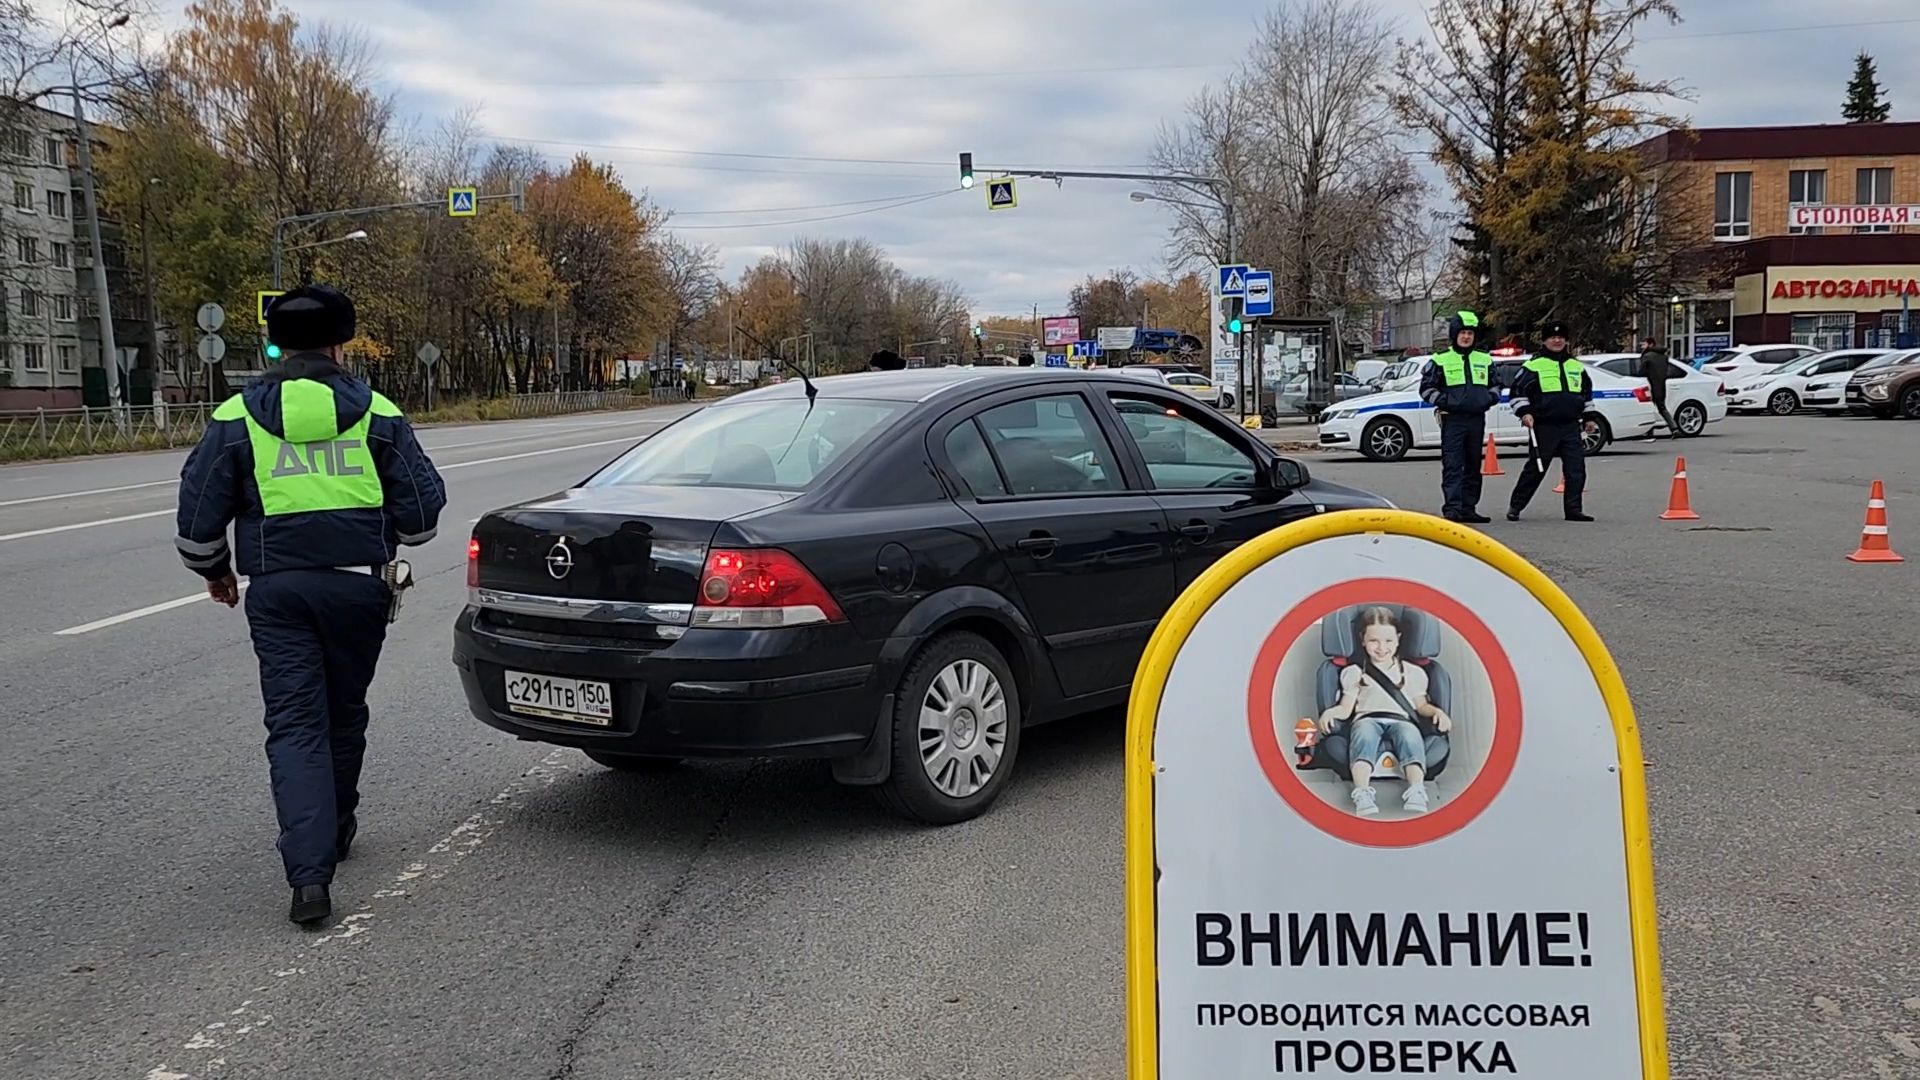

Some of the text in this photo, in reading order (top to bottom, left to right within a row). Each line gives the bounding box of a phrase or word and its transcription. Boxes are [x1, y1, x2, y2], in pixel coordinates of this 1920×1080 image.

[1796, 207, 1909, 225] СТОЛОВАЯ
[270, 439, 363, 478] ДПС
[586, 703, 599, 713] RUS
[1195, 912, 1592, 967] ВНИМАНИЕ!
[1197, 1003, 1590, 1032] ПРОВОДИТСЯ МАССОВАЯ
[1274, 1040, 1517, 1074] ПРОВЕРКА
